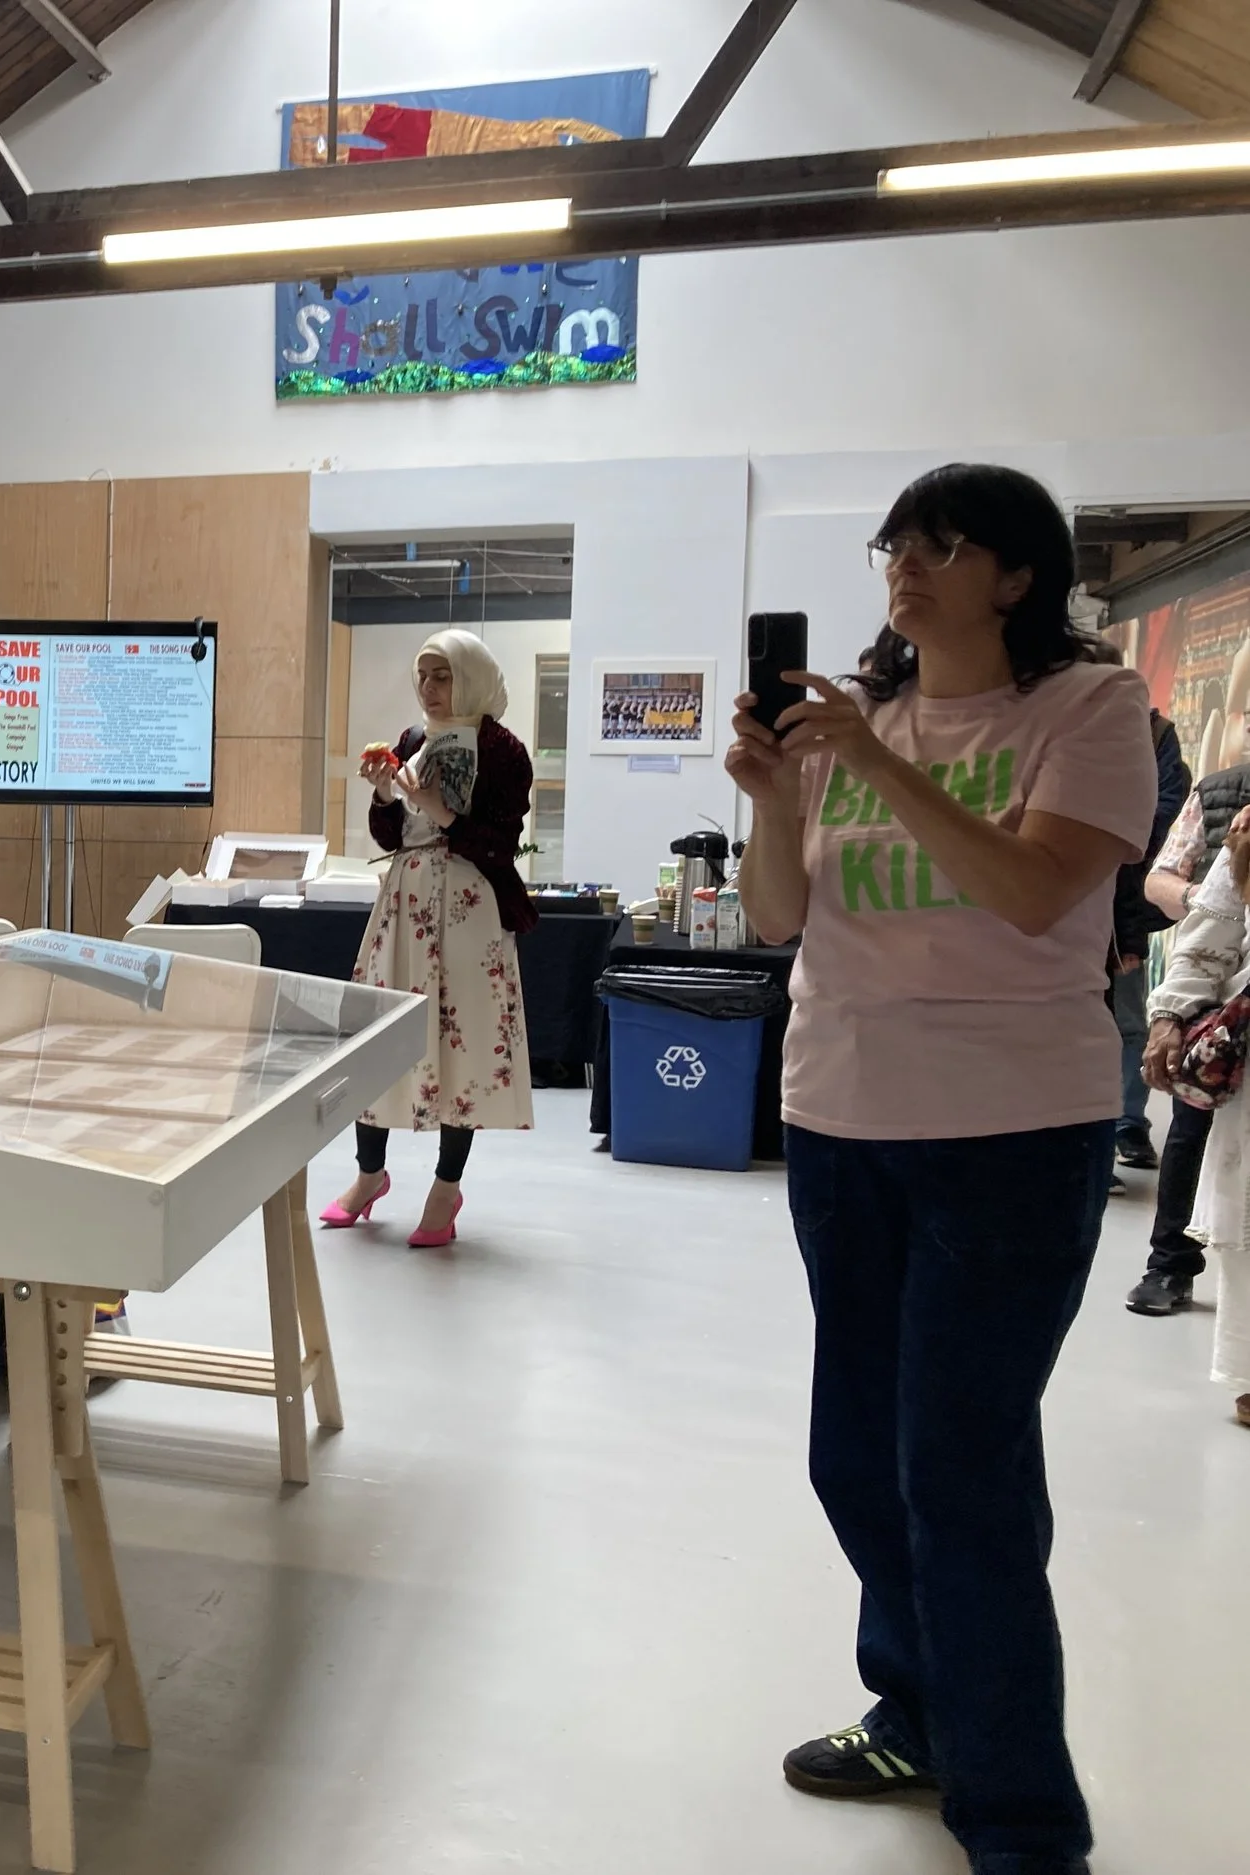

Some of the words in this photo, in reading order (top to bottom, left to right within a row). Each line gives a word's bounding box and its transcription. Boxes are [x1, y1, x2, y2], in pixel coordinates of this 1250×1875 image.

[56, 643, 73, 653] SAVE
[76, 643, 90, 653] OUR
[92, 643, 111, 653] POOL
[841, 840, 978, 912] KIL
